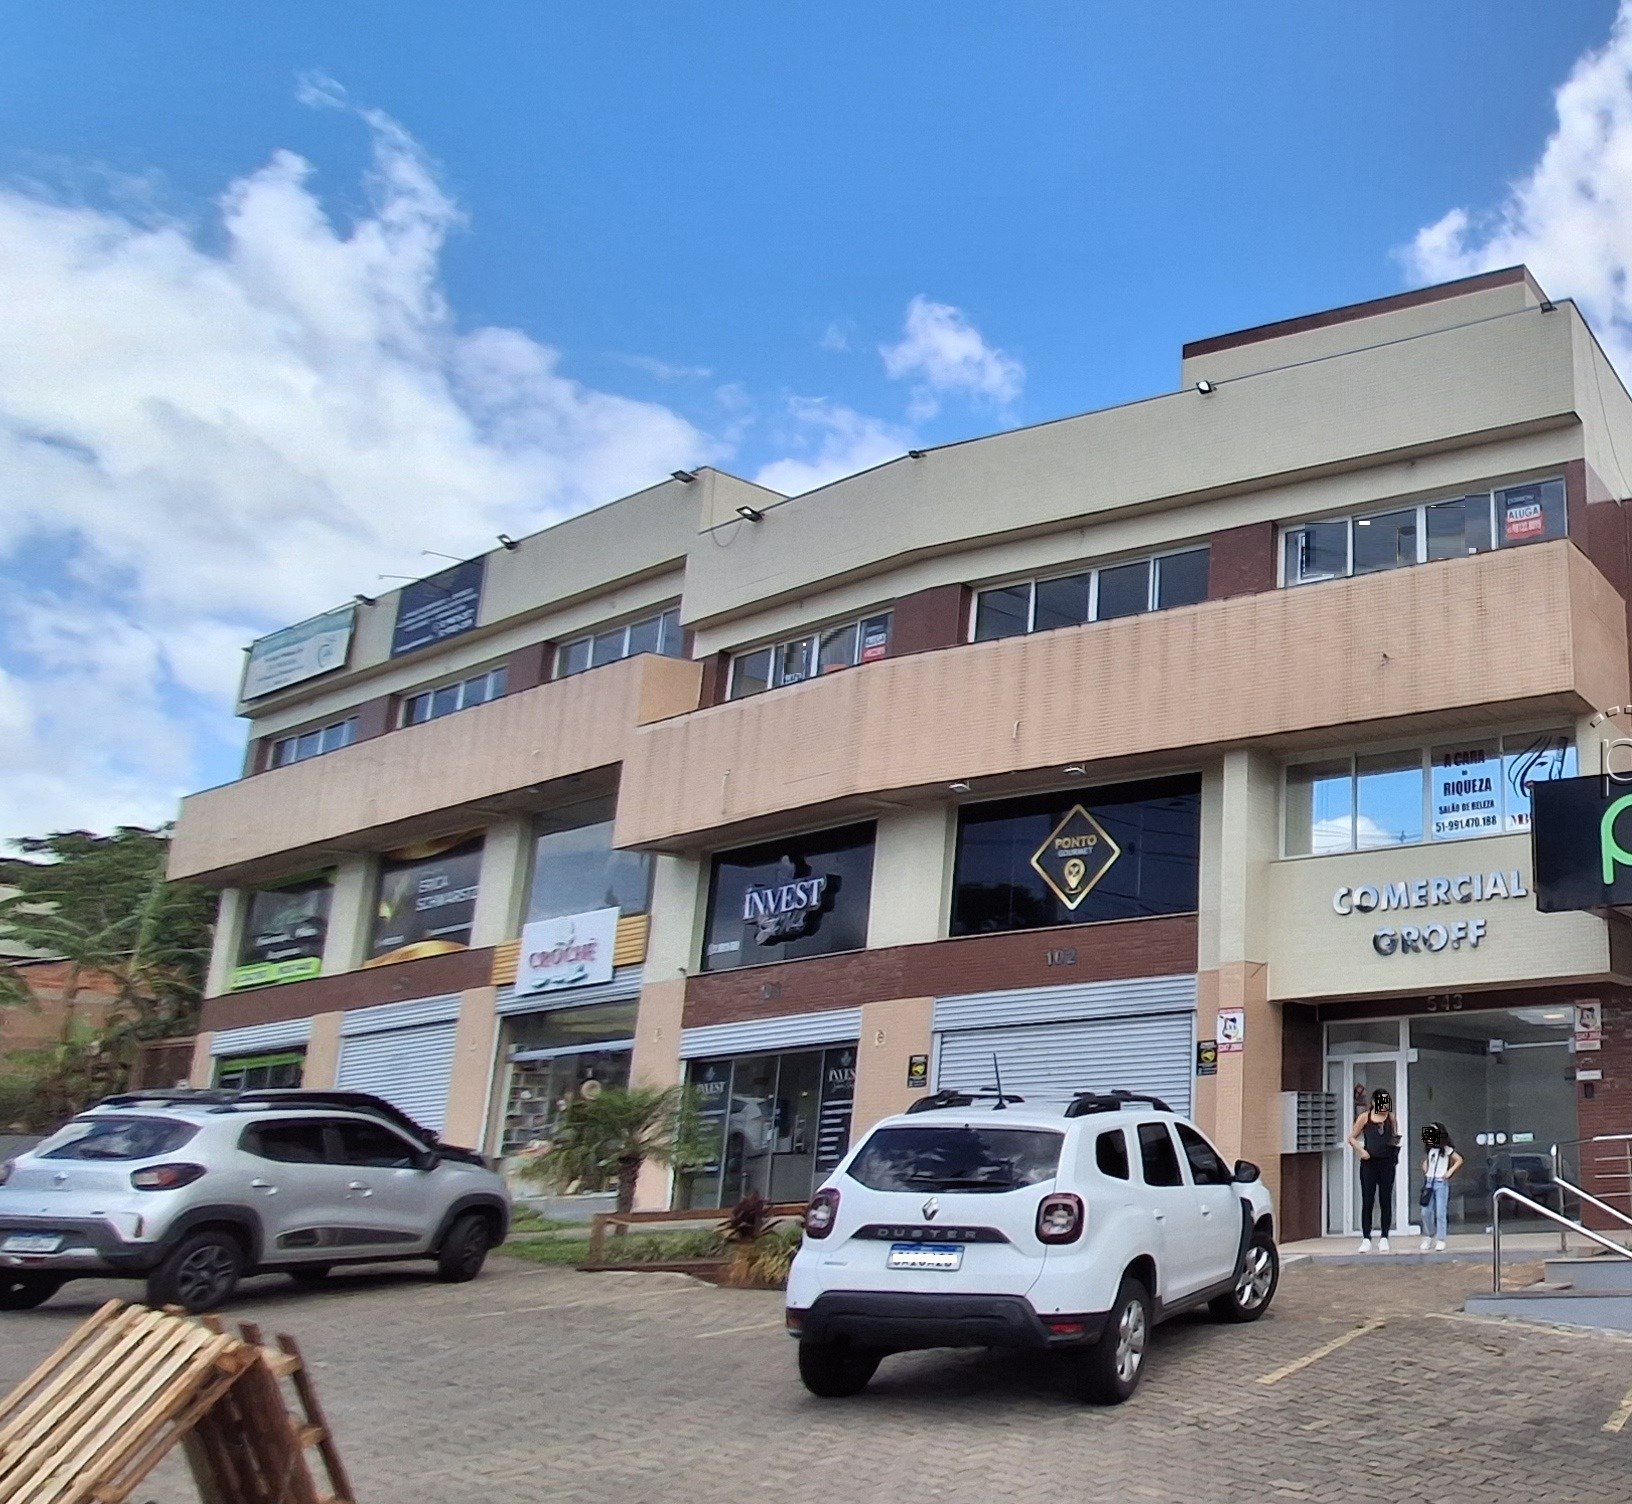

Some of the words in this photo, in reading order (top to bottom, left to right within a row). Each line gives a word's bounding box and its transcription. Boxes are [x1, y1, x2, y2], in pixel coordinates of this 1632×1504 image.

[1508, 507, 1539, 520] ALUGA
[1443, 778, 1492, 797] RIQUEZA
[1462, 803, 1470, 811] DE
[1055, 834, 1098, 850] PONTO
[1058, 846, 1094, 857] GOURMET
[743, 877, 826, 921] INVEST
[1332, 869, 1528, 916] COMERCIAL
[1372, 919, 1487, 956] GROFF
[1045, 949, 1077, 966] 102
[1426, 994, 1464, 1012] 543
[877, 1228, 976, 1239] DUSTER
